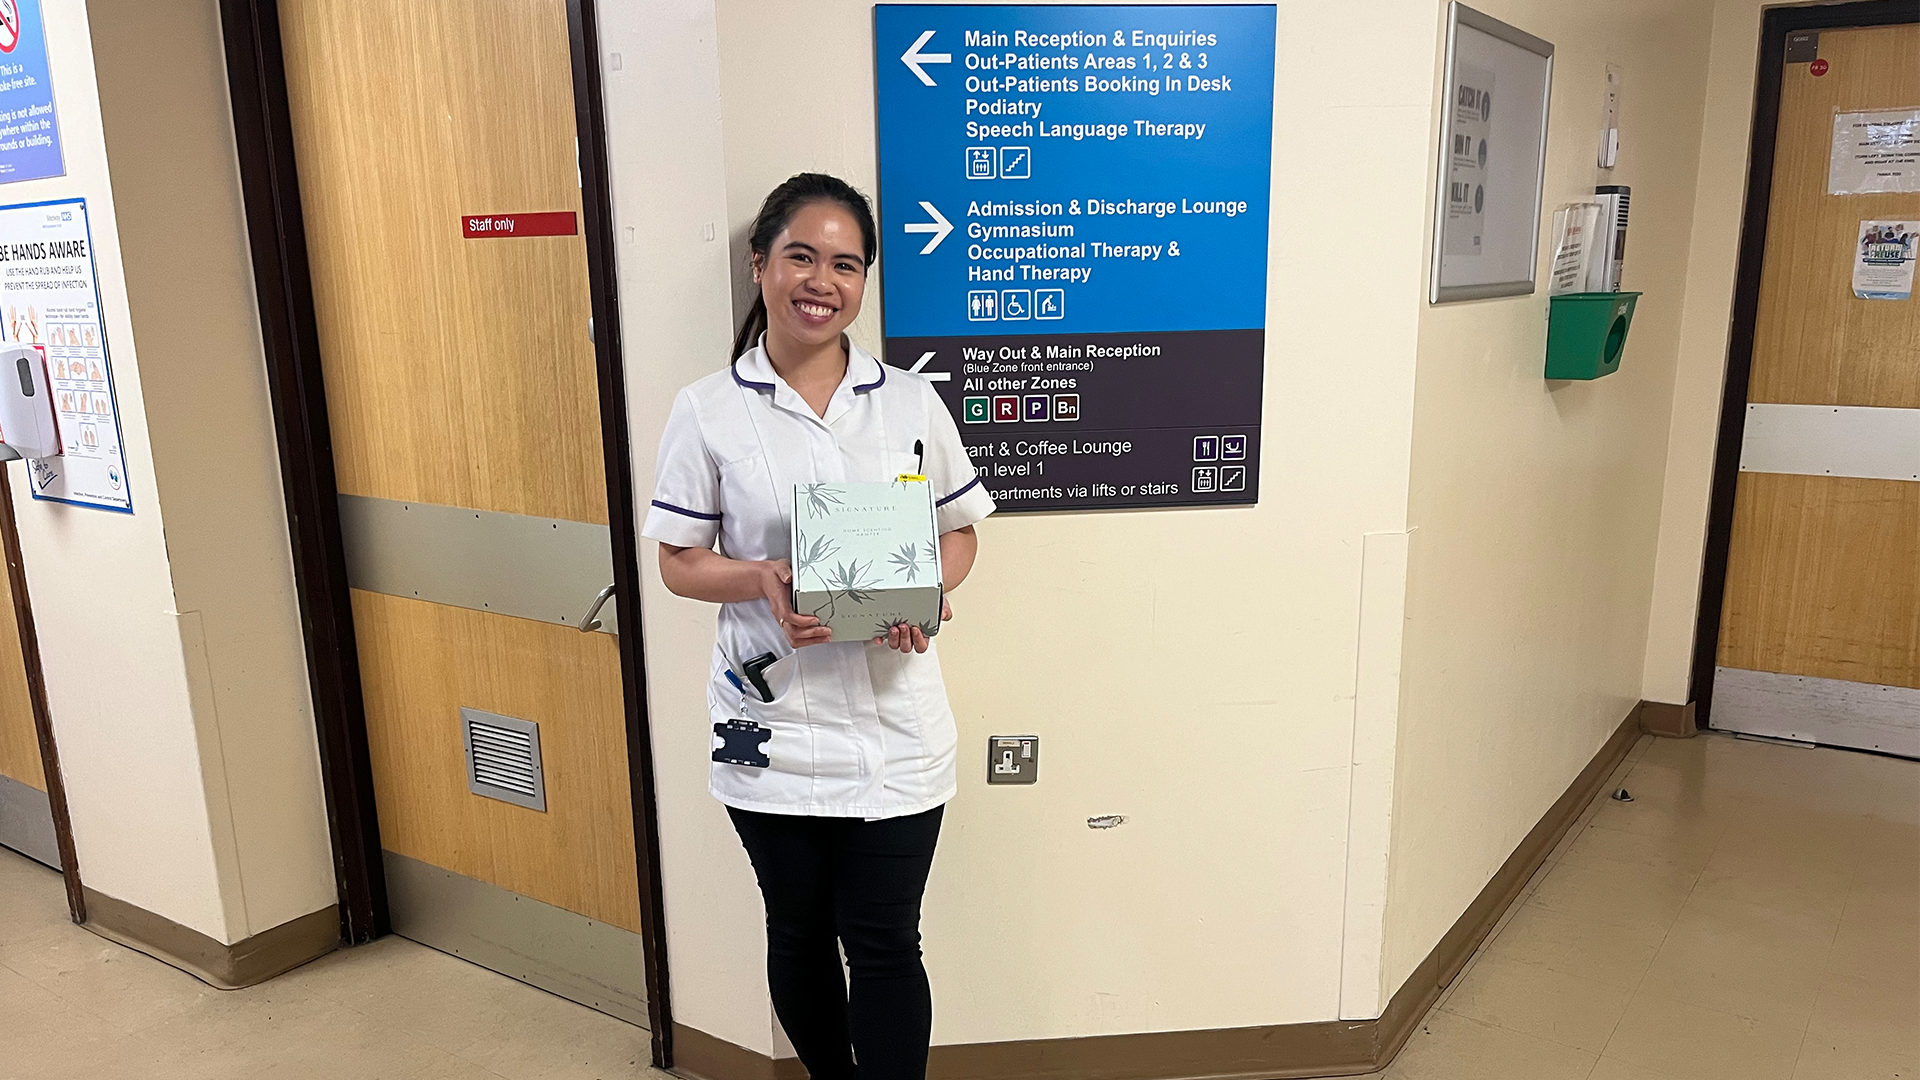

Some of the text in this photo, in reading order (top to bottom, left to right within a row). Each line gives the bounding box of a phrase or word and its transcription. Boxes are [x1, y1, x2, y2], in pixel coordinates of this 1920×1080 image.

[965, 30, 1217, 50] Main Reception & Enquiries
[0, 62, 23, 76] This is a
[965, 53, 1208, 72] Out-Patients Areas 1, 2 & 3
[24, 75, 37, 87] site.
[965, 75, 1232, 95] Out-Patients Booking In Desk
[11, 109, 17, 119] is
[17, 108, 28, 118] not
[29, 102, 52, 116] allowed
[966, 99, 1042, 118] Podiatry
[20, 120, 39, 133] within
[40, 118, 51, 130] the
[966, 120, 1206, 141] Speech Language Therapy
[19, 139, 25, 148] or
[26, 134, 53, 147] building.
[967, 198, 1247, 218] Admission & Discharge Lounge
[470, 218, 514, 232] Staff only
[967, 221, 1074, 242] Gymnasium
[0, 240, 86, 261] BE HANDS AWARE
[968, 240, 1181, 263] Occupational Therapy &
[6, 265, 82, 276] USE THE HAND RUB AND HELP US
[968, 265, 1092, 283] Hand Therapy
[4, 280, 87, 290] PREVENT THE SPREAD OF INFECTION
[963, 344, 1161, 363] Way Out & Main Reception
[963, 361, 1094, 375] (Blue Zone front entrance)
[963, 377, 1077, 391] All other Zones
[971, 401, 1075, 416] G R P Bn
[999, 442, 1010, 456] &
[1016, 440, 1068, 456] Coffee
[1073, 440, 1132, 456] Lounge
[994, 462, 1030, 476] level
[1037, 461, 1043, 475] 1
[1067, 484, 1087, 498] via
[1092, 483, 1116, 497] lifts
[1121, 484, 1135, 496] or
[1140, 482, 1178, 495] stairs
